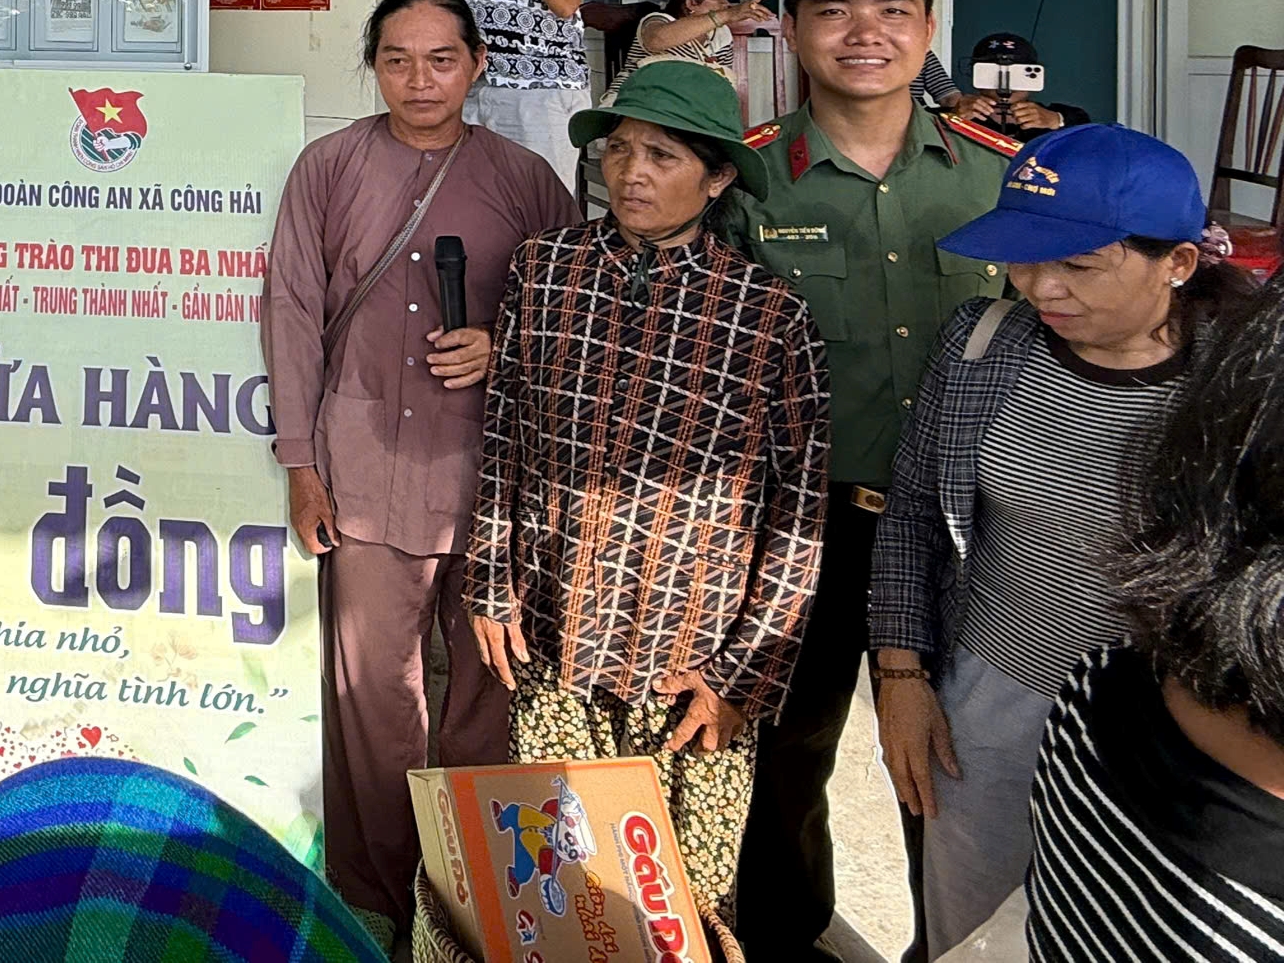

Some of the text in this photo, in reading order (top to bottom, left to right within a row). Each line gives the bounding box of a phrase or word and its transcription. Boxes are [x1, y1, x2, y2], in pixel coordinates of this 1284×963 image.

[48, 181, 99, 208] CÔNG
[106, 187, 132, 209] AN
[139, 183, 164, 210] XÃ
[171, 184, 223, 212] CÔNG
[230, 183, 261, 214] HẢI
[15, 239, 74, 270] TRÀO
[81, 245, 120, 272] THI
[126, 247, 172, 274] ĐUA
[180, 249, 211, 276] BA
[33, 286, 77, 315] TRUNG
[82, 283, 127, 316] THÀNH
[132, 281, 168, 318] NHẤT
[216, 288, 244, 322] DÂN
[82, 357, 277, 435] HÀNG
[30, 465, 288, 645] đồng
[56, 626, 131, 659] nhỏ,
[5, 671, 107, 702] nghĩa
[118, 677, 189, 706] tình
[624, 815, 671, 914] Gấu
